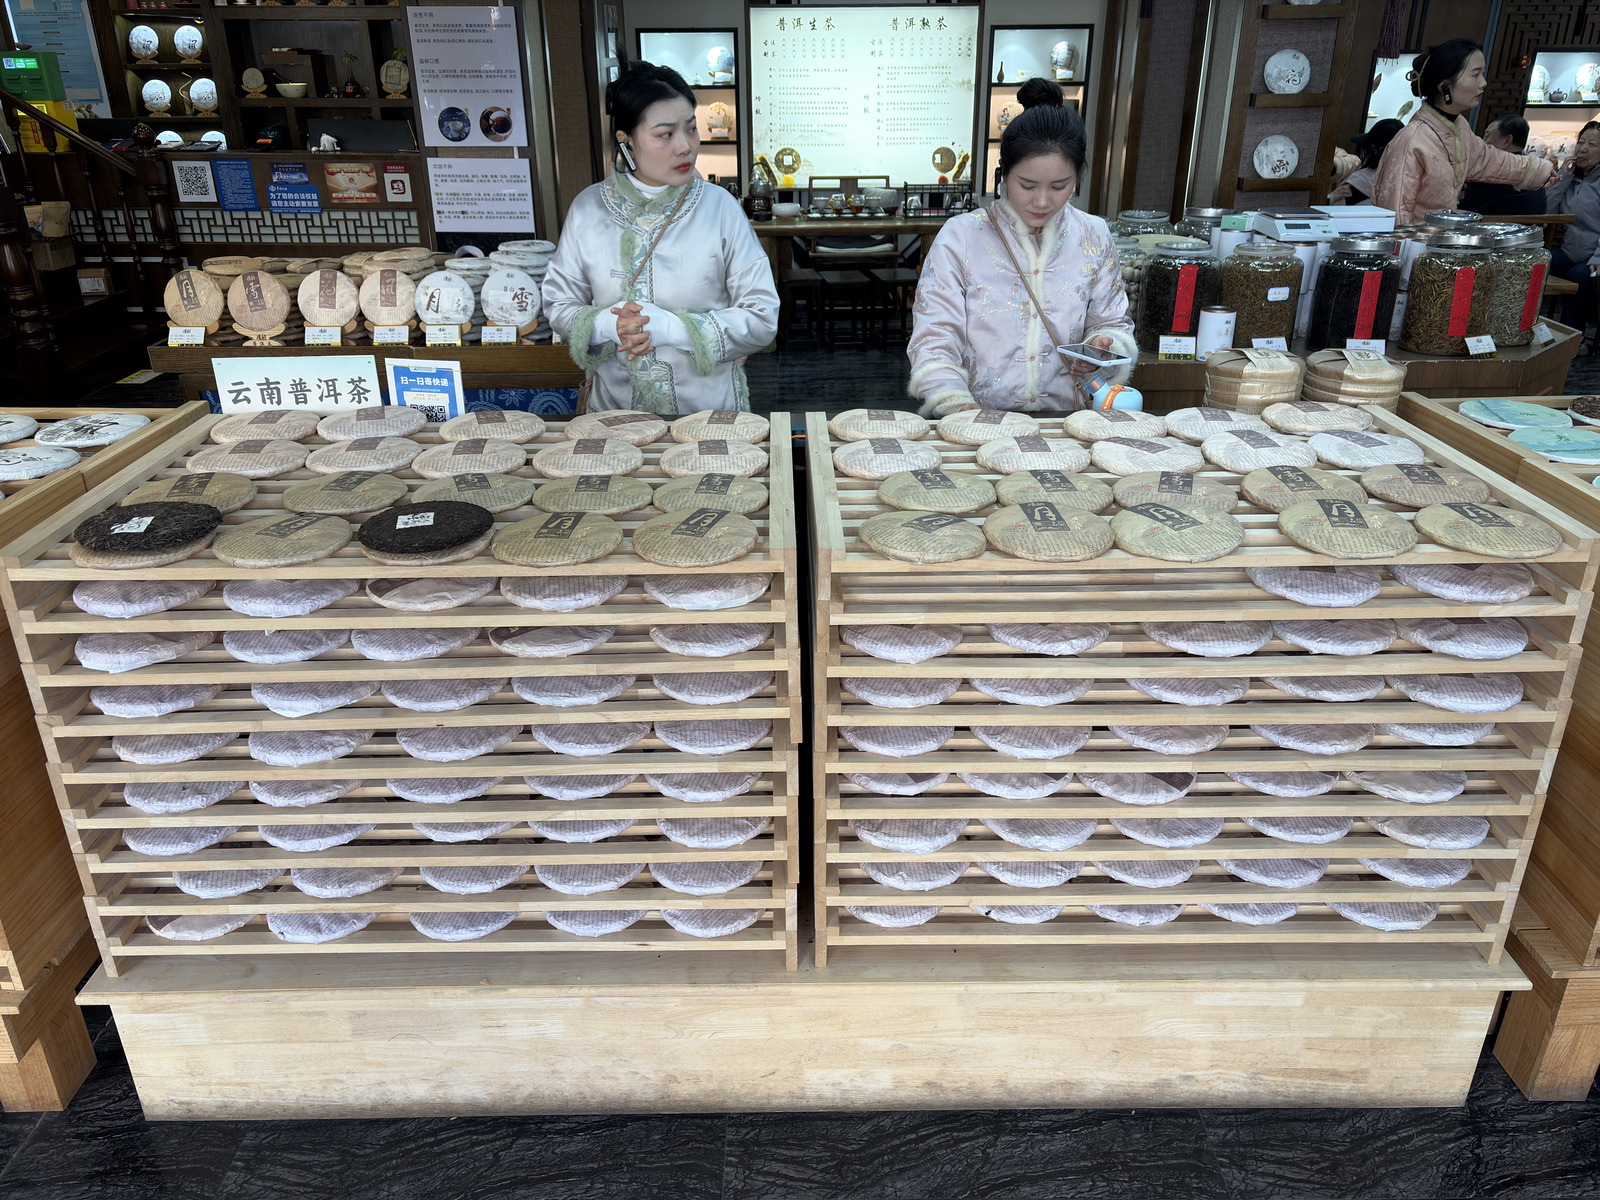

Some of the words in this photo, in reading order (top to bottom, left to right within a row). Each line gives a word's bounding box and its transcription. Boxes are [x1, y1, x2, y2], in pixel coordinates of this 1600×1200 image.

[776, 17, 836, 32] 普洱生茶
[889, 16, 948, 31] 普洱熟茶
[425, 288, 441, 314] 月
[512, 287, 533, 313] 雪
[227, 377, 372, 406] 云南普洱茶
[400, 376, 449, 387] 扫一扫寄快递
